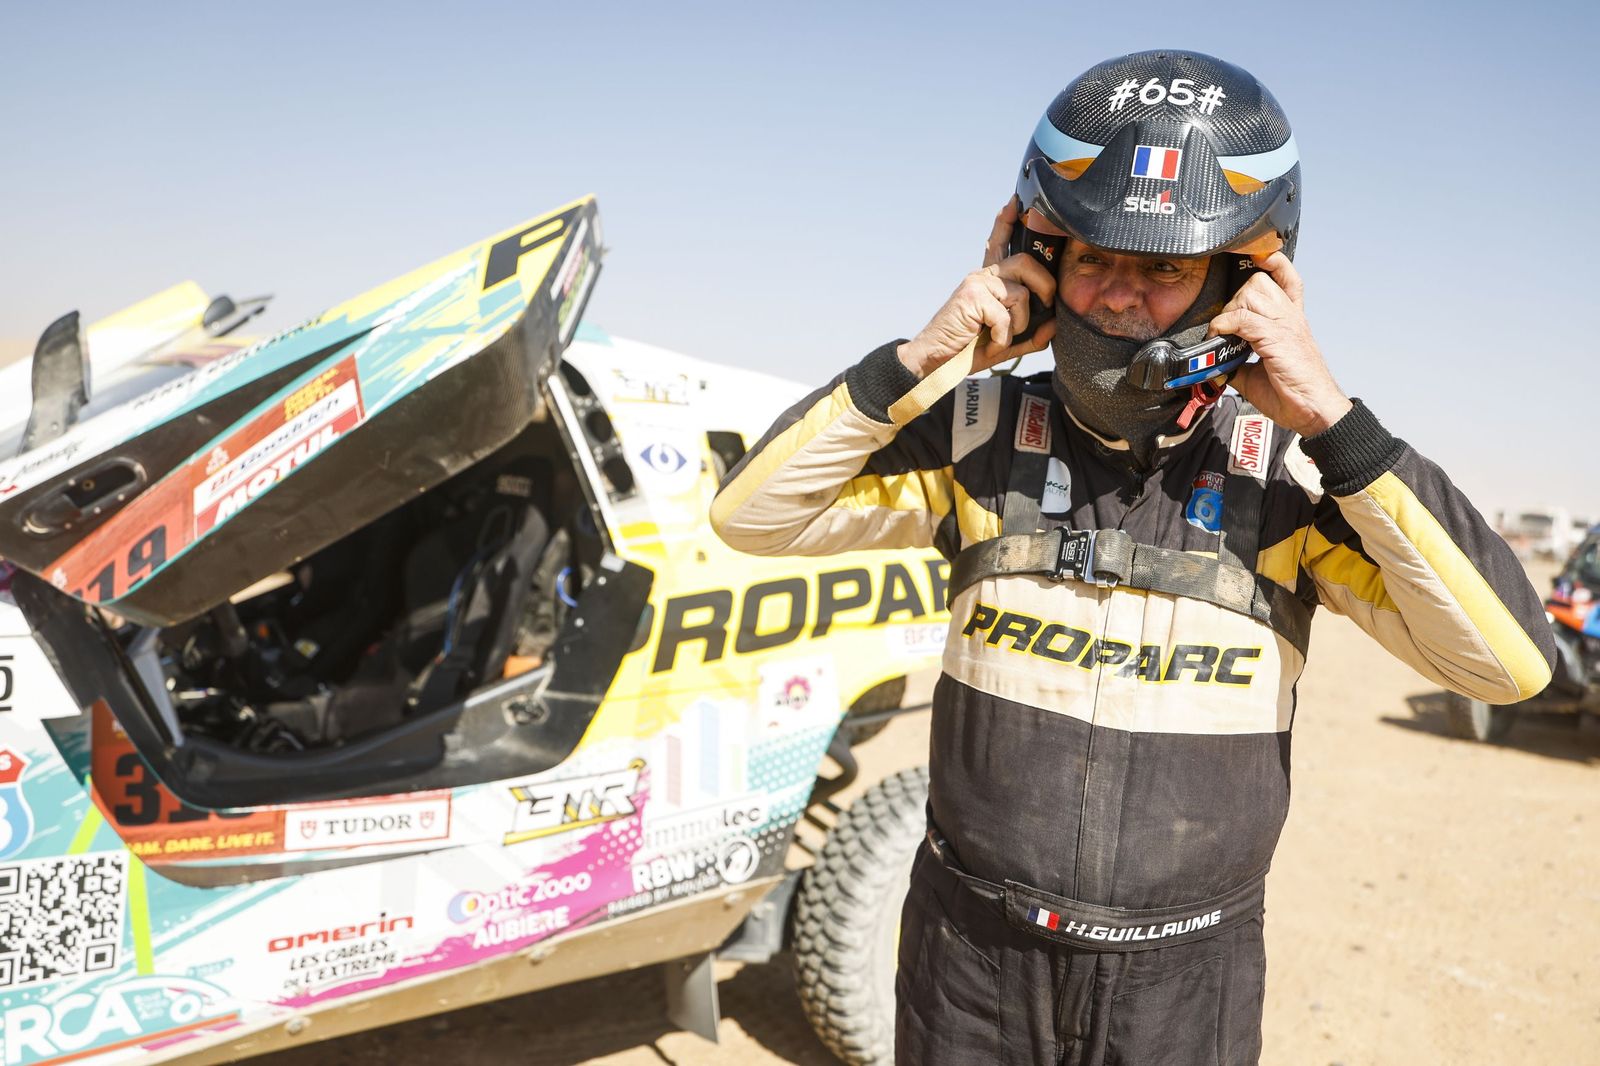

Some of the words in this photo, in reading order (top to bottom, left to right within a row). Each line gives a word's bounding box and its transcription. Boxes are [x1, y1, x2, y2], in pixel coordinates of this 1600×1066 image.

[1108, 77, 1227, 116] #65#
[1124, 189, 1176, 215] Stilo
[1032, 240, 1053, 261] Stilo
[1239, 259, 1257, 270] St
[1025, 400, 1048, 446] SIMPSON
[1239, 420, 1263, 469] SIMPSON
[213, 424, 342, 527] MOTUL
[71, 524, 168, 601] 19
[961, 602, 1261, 686] PROPARC
[324, 814, 412, 836] TUDOR
[631, 852, 696, 893] RBW
[460, 885, 531, 919] Optic
[531, 872, 592, 902] 2000
[268, 911, 414, 953] omerin
[1065, 909, 1222, 942] H.GUILLAUME
[290, 953, 319, 971] LES
[324, 938, 389, 962] CABLES
[0, 985, 143, 1064] RCA
